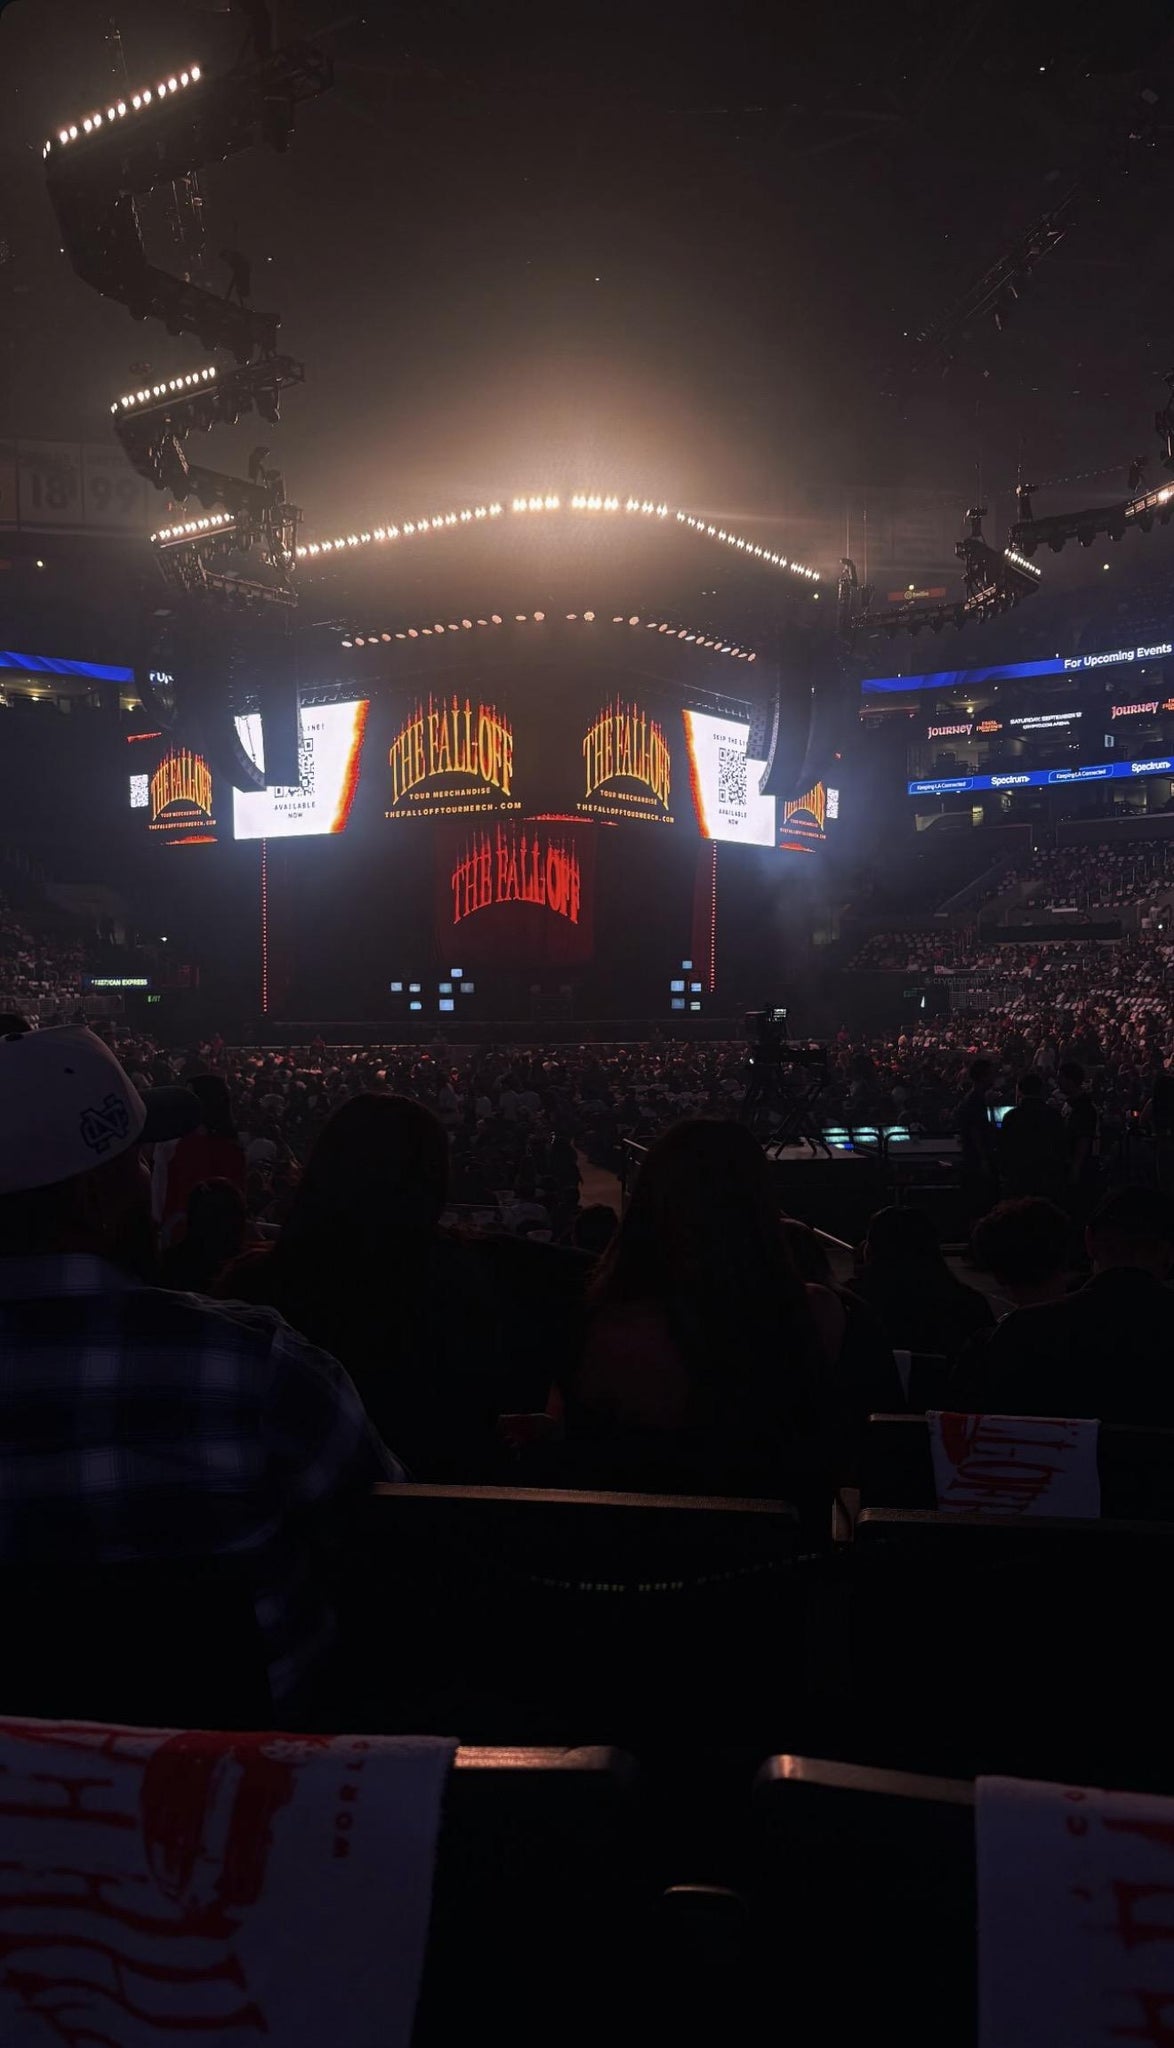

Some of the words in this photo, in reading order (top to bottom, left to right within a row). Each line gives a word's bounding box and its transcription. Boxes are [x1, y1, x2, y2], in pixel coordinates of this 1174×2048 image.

[1064, 659, 1081, 669] For
[1083, 649, 1134, 667] Upcoming
[1137, 643, 1172, 658] Events
[306, 723, 325, 731] INE!
[713, 733, 726, 741] SKIP
[728, 737, 738, 745] THE
[390, 706, 425, 805] THE
[428, 695, 514, 796] FALL-OFF
[583, 705, 613, 797] THE
[615, 695, 670, 810] FALL-OFF
[1131, 761, 1167, 773] Spectrum
[991, 775, 1027, 786] Spectrum
[151, 756, 170, 821] THE
[433, 787, 491, 798] MERCHANDISE
[600, 790, 616, 798] TOUR
[274, 801, 316, 811] AVAILABLE
[384, 802, 522, 818] THEFALLOFFTOURMERCH.COM
[452, 834, 492, 924] THE
